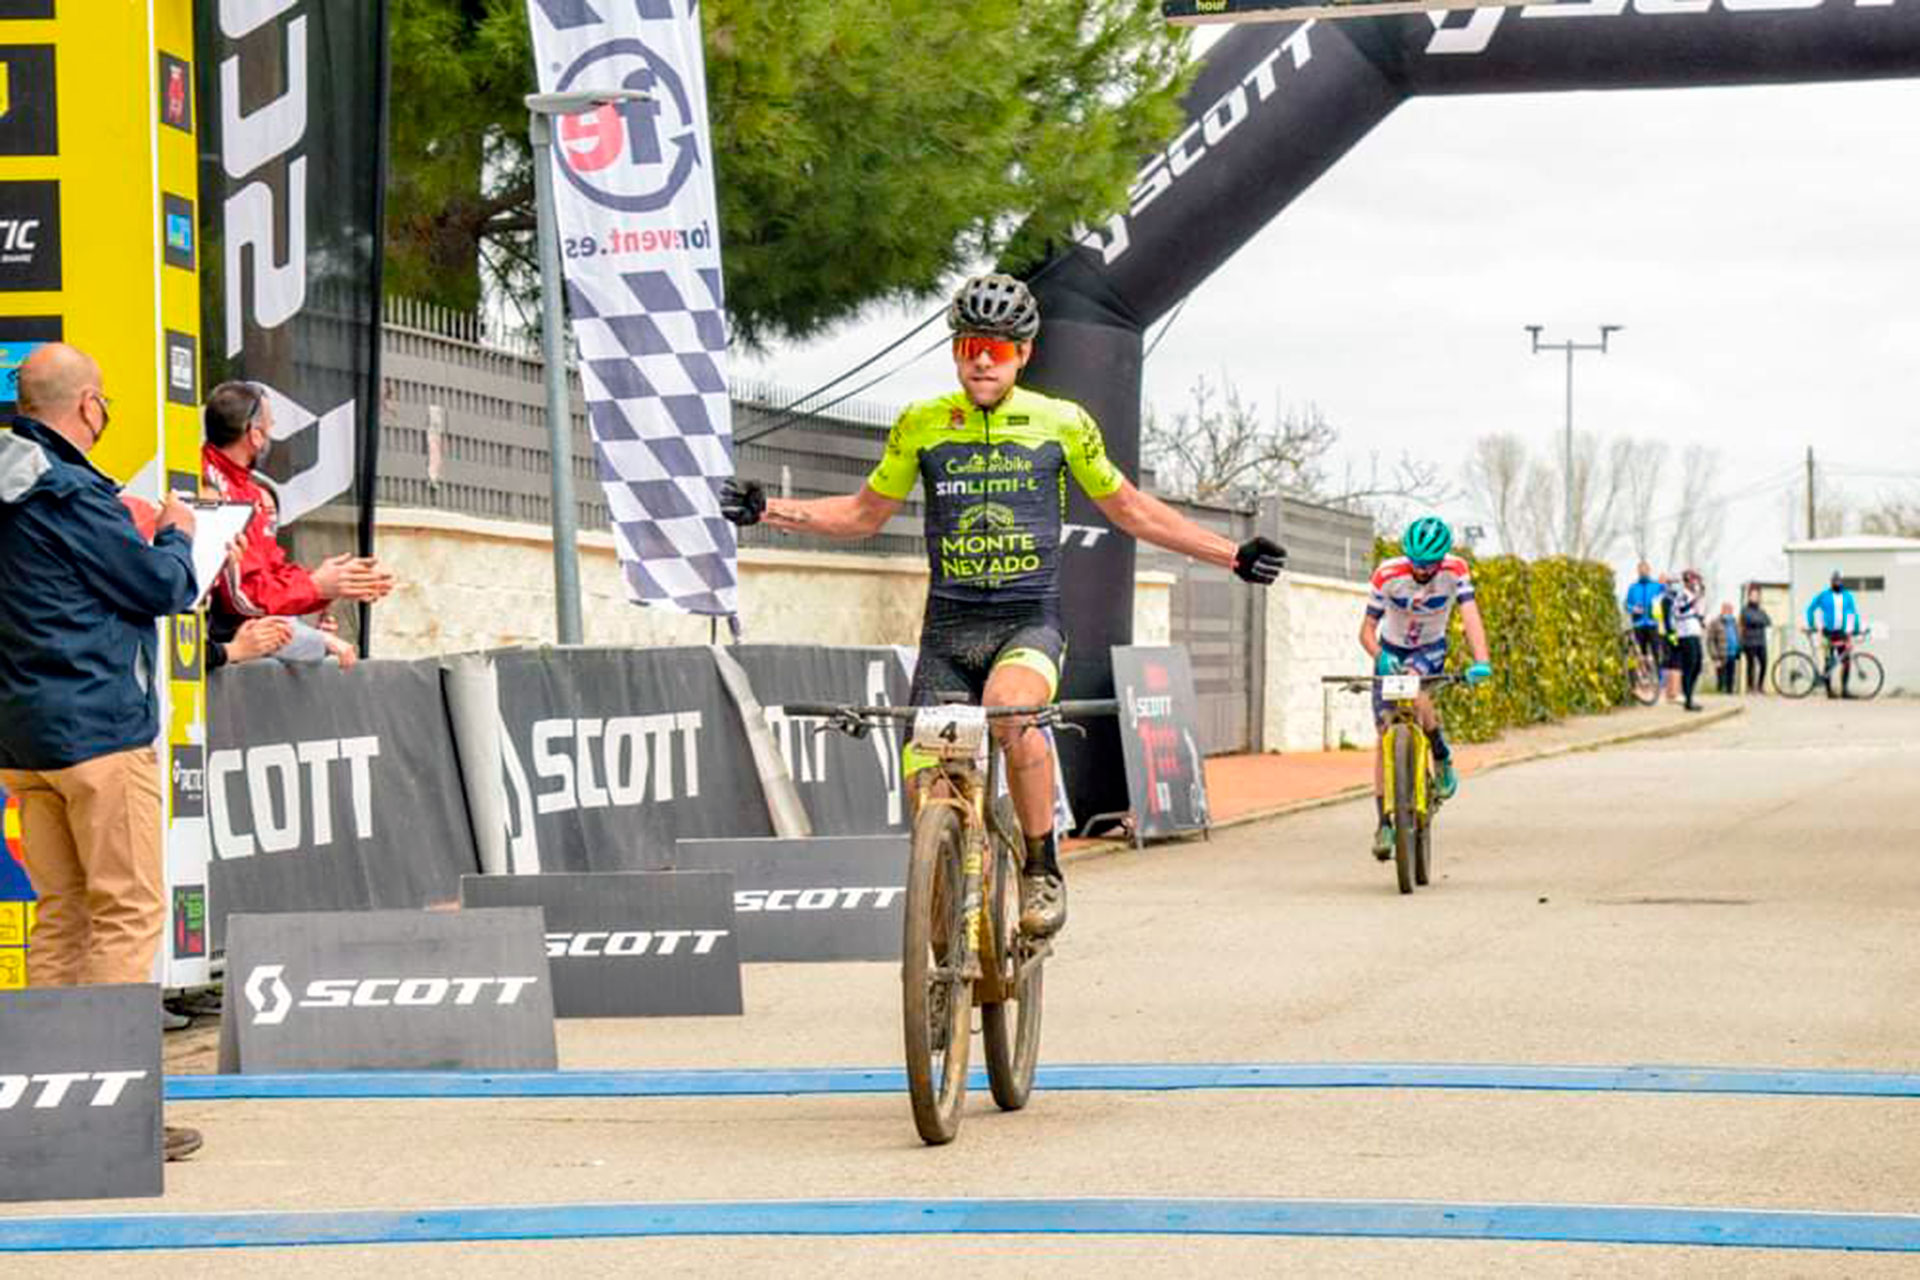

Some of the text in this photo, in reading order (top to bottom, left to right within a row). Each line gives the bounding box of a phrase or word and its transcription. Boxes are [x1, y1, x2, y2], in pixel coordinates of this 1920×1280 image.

[1127, 18, 1317, 217] SCOTT
[941, 533, 1036, 556] MONTE
[941, 554, 1040, 578] NEVADO
[938, 720, 958, 744] 4
[532, 710, 703, 814] SCOTT
[204, 735, 380, 861] COTT
[734, 886, 907, 913] SCOTT
[299, 976, 538, 1008] SCOTT
